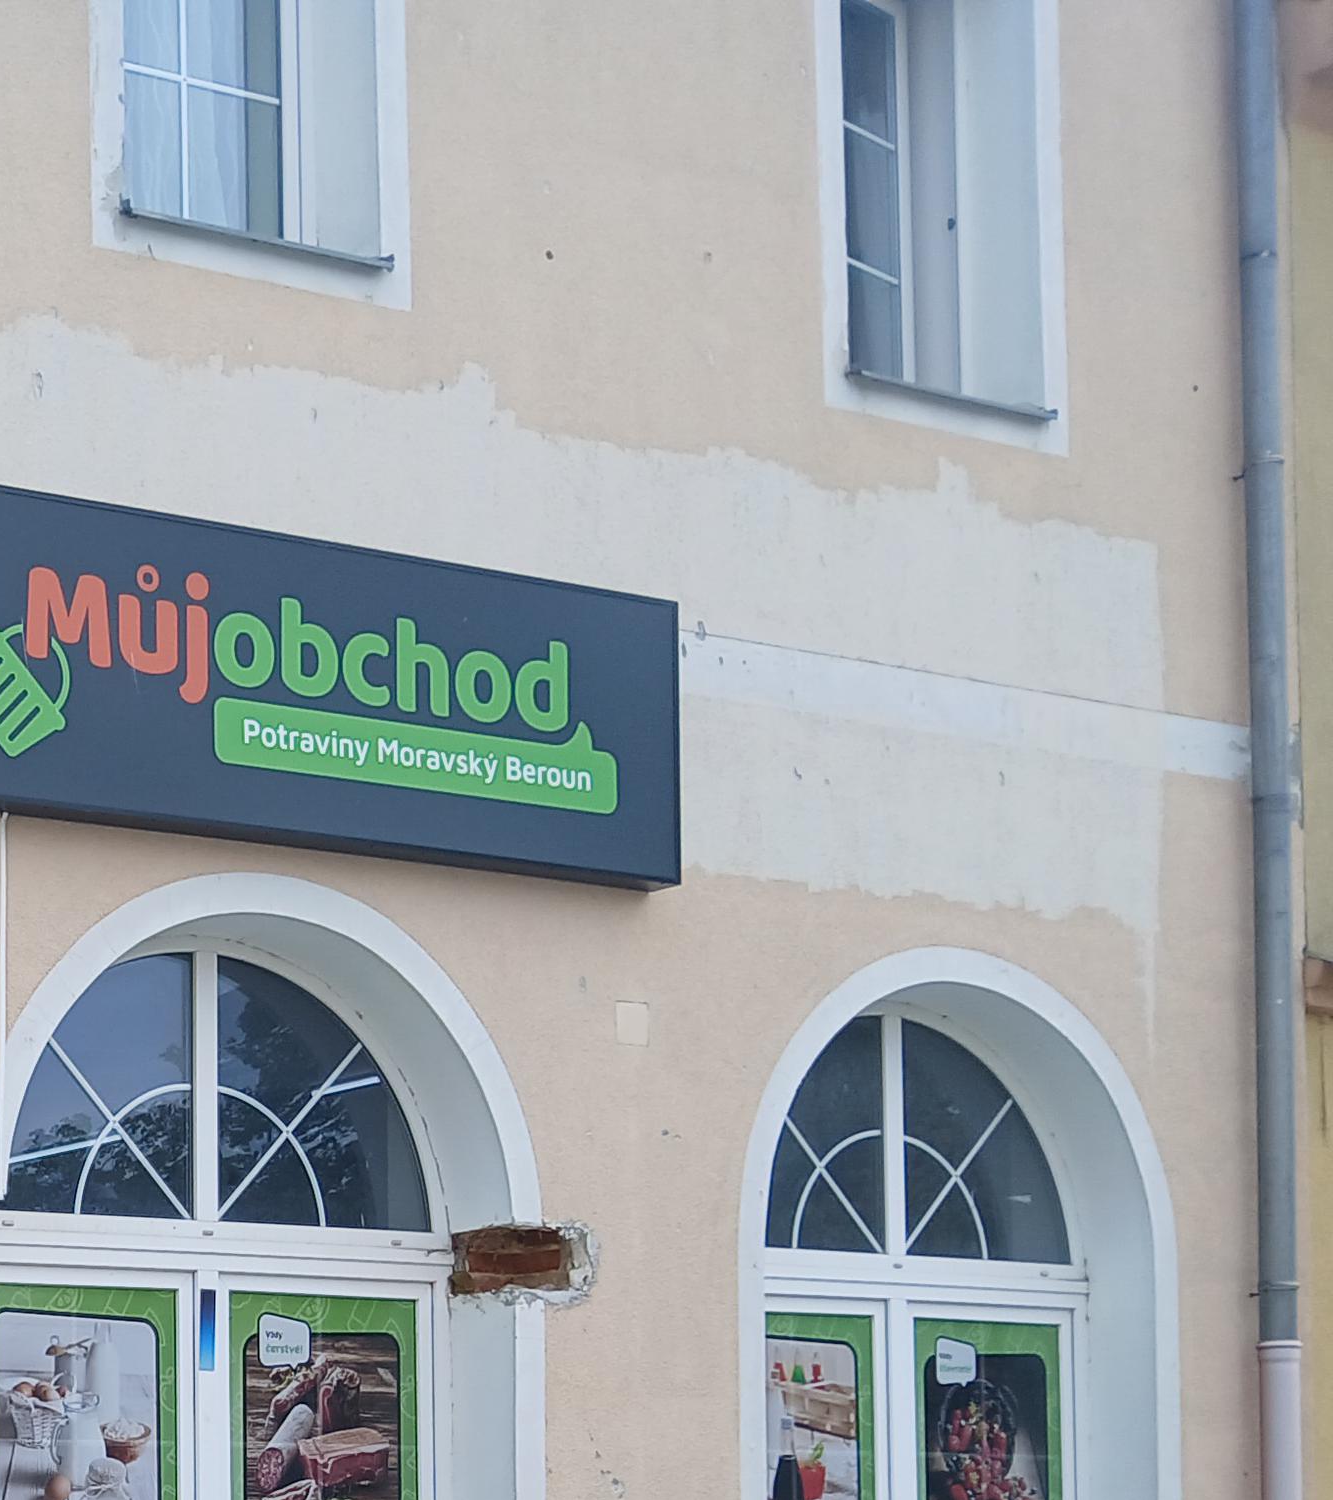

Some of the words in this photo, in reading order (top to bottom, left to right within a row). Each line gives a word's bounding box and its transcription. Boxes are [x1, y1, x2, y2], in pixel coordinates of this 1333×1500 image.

[243, 718, 369, 766] Potraviny
[377, 737, 498, 784] Moravský
[505, 756, 593, 793] Beroun
